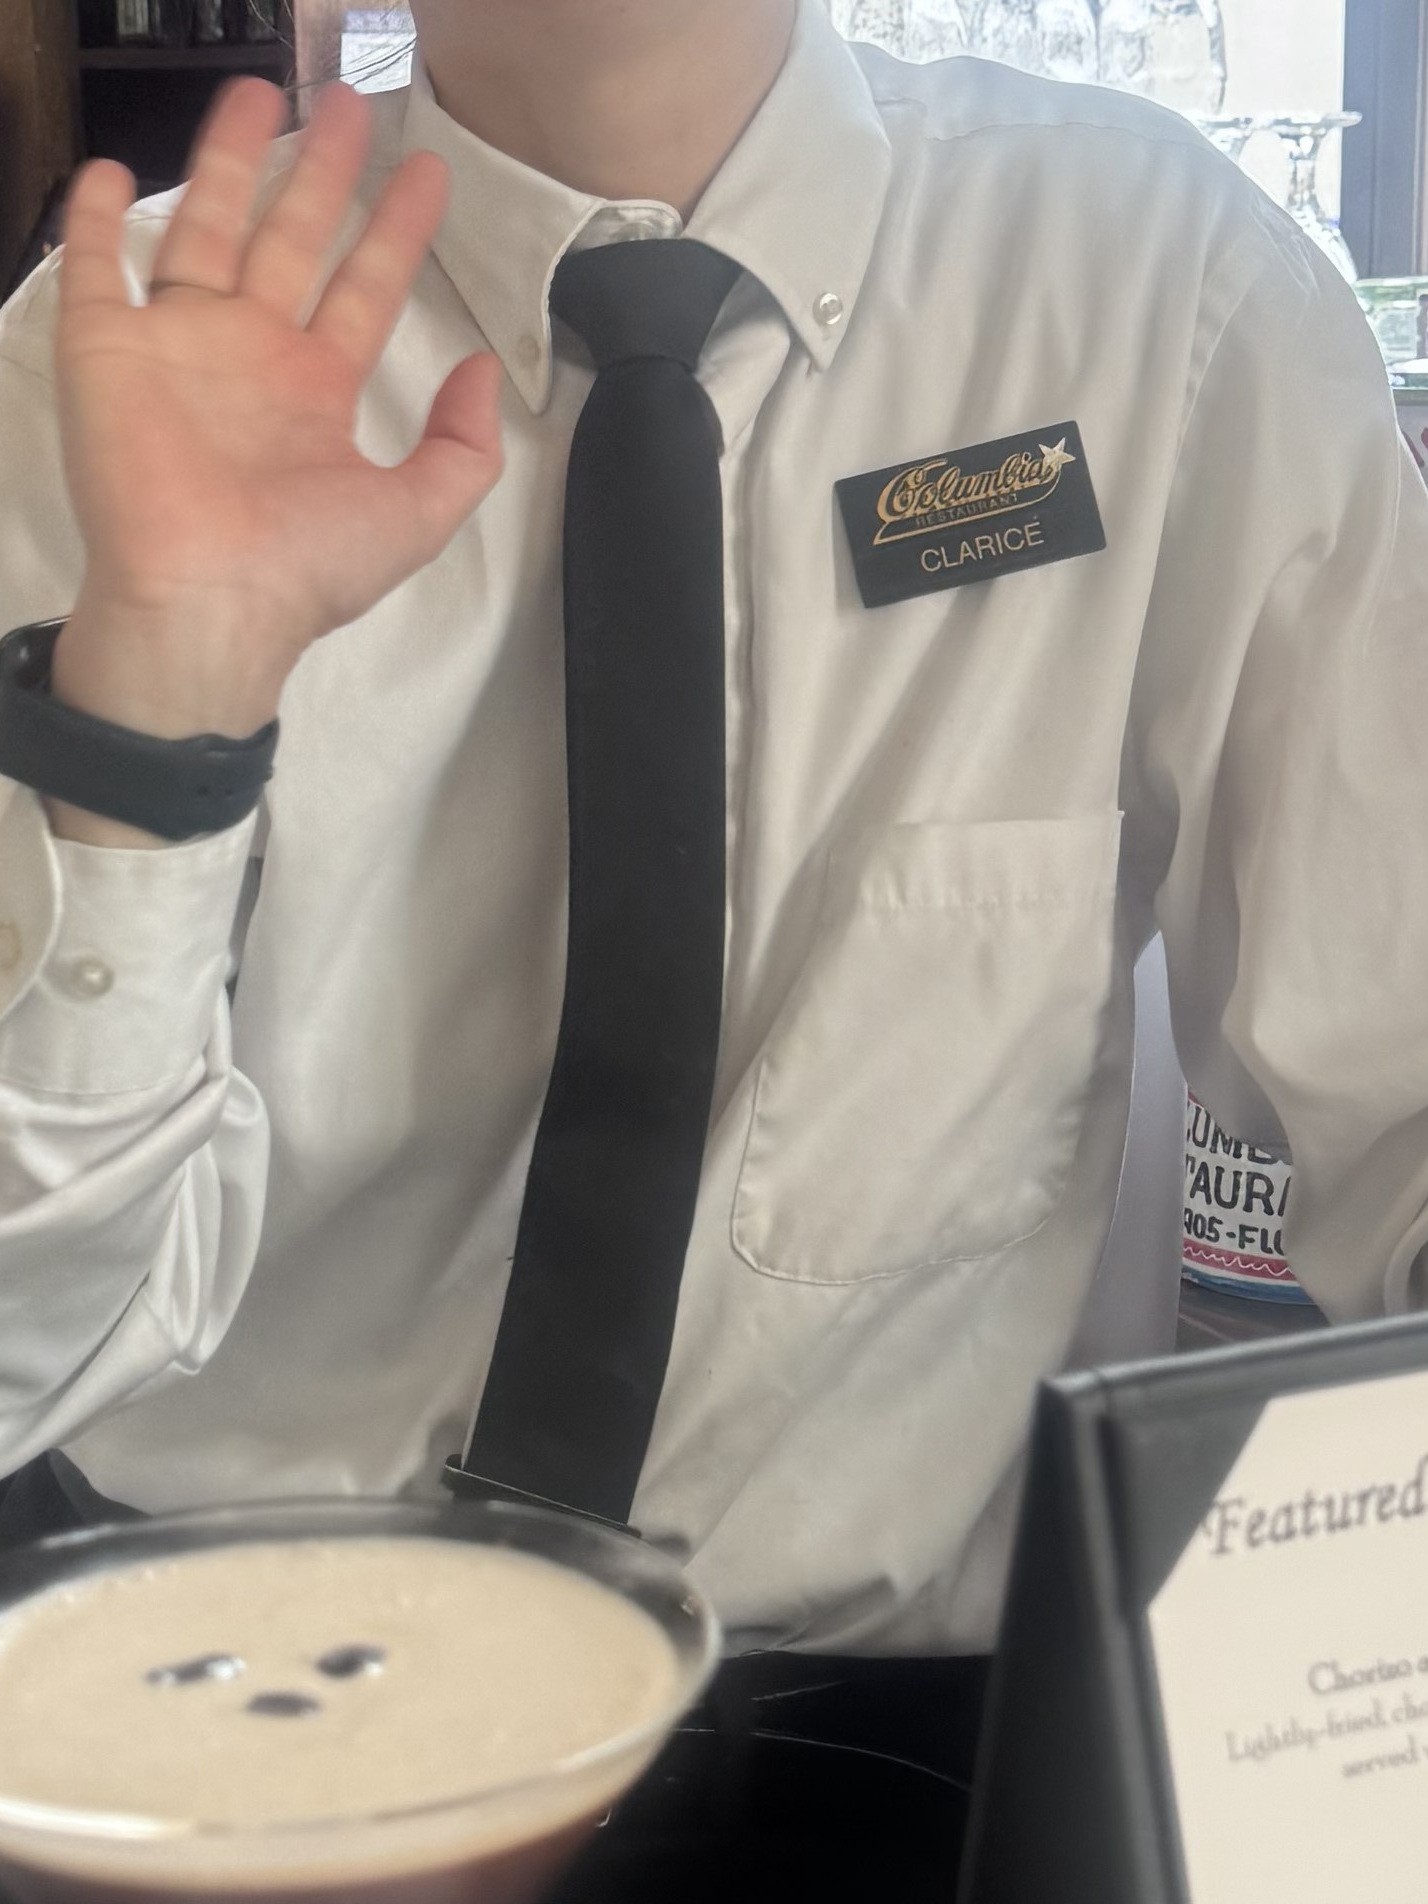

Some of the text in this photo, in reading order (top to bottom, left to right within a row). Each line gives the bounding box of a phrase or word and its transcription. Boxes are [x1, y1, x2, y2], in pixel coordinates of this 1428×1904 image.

[876, 450, 1061, 523] Columbia
[921, 521, 1045, 573] CLARICE
[1305, 1657, 1414, 1699] Chorizo
[1340, 1736, 1421, 1779] served
